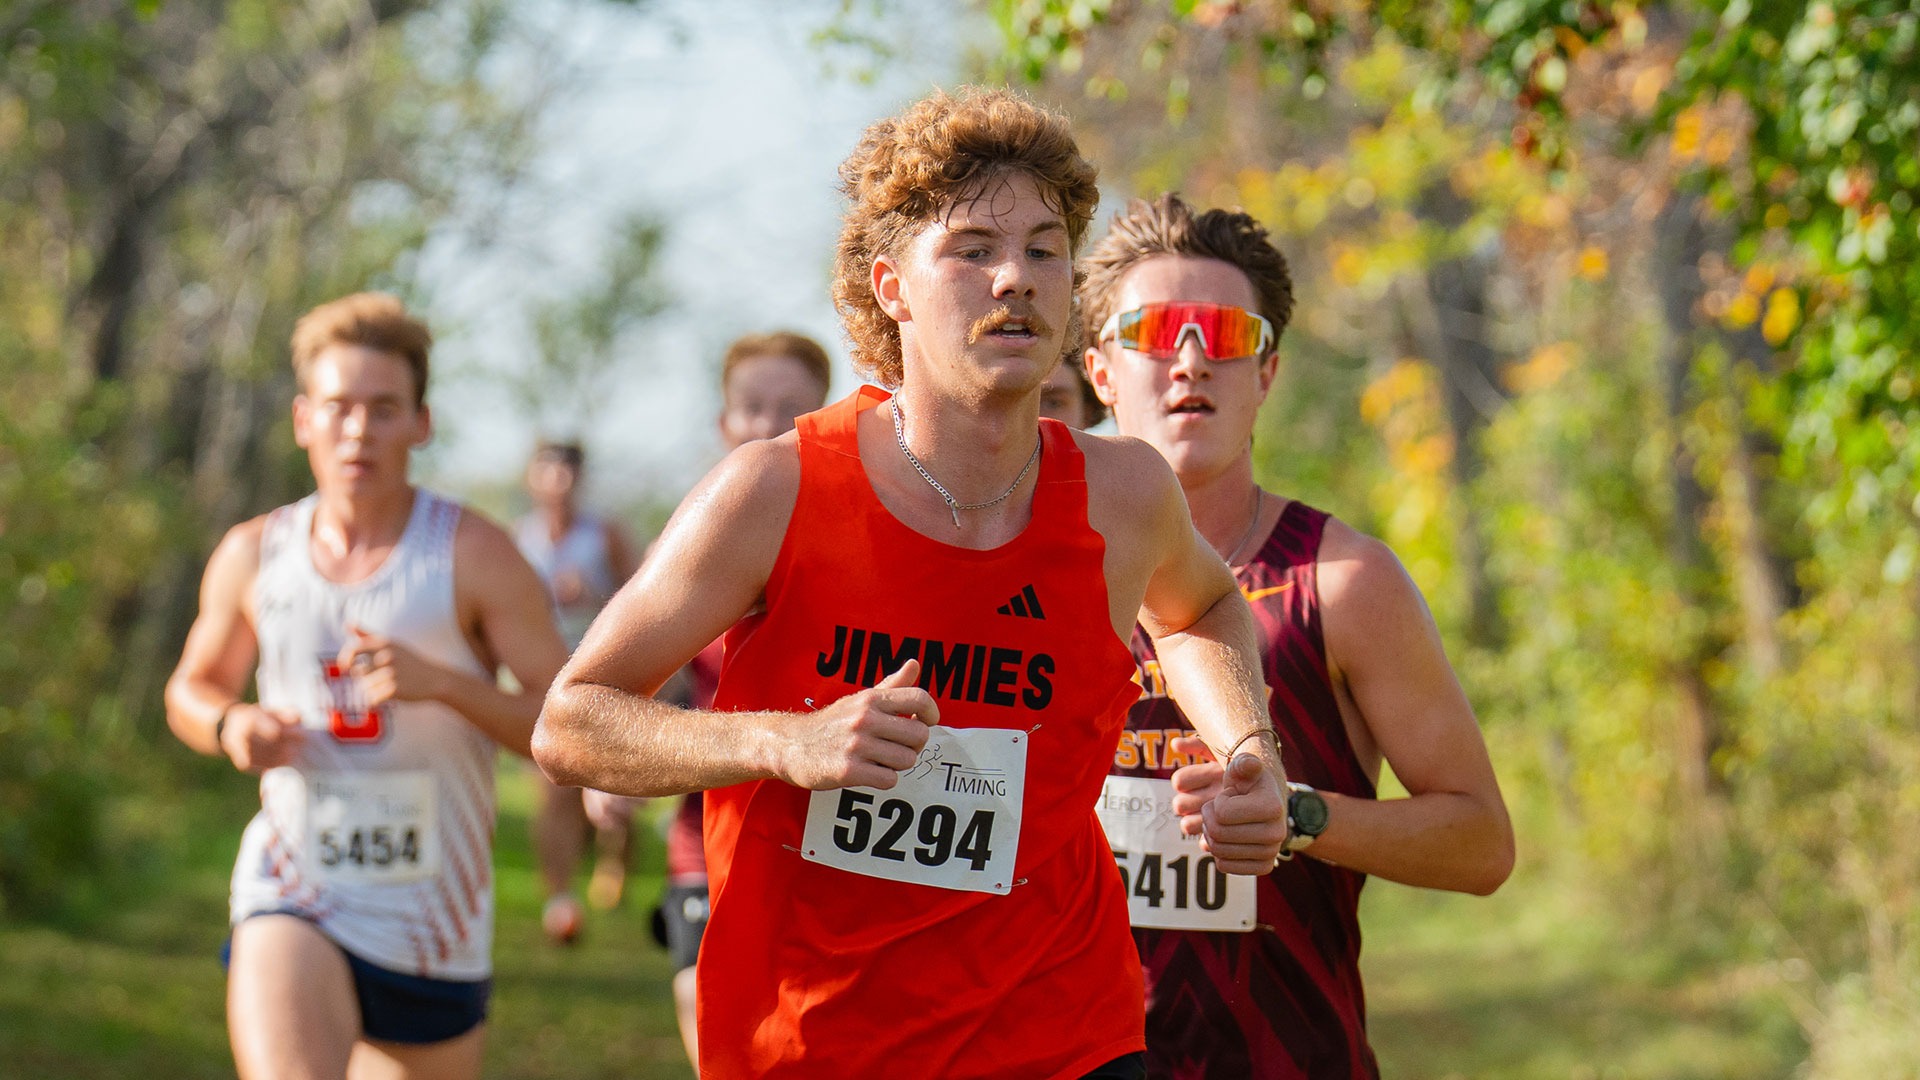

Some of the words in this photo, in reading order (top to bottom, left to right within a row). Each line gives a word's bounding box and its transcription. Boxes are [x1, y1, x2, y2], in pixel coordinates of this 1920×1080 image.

[816, 625, 1055, 711] JIMMIES
[940, 762, 1006, 797] TIMING
[318, 826, 420, 867] 5454
[833, 788, 996, 871] 5294
